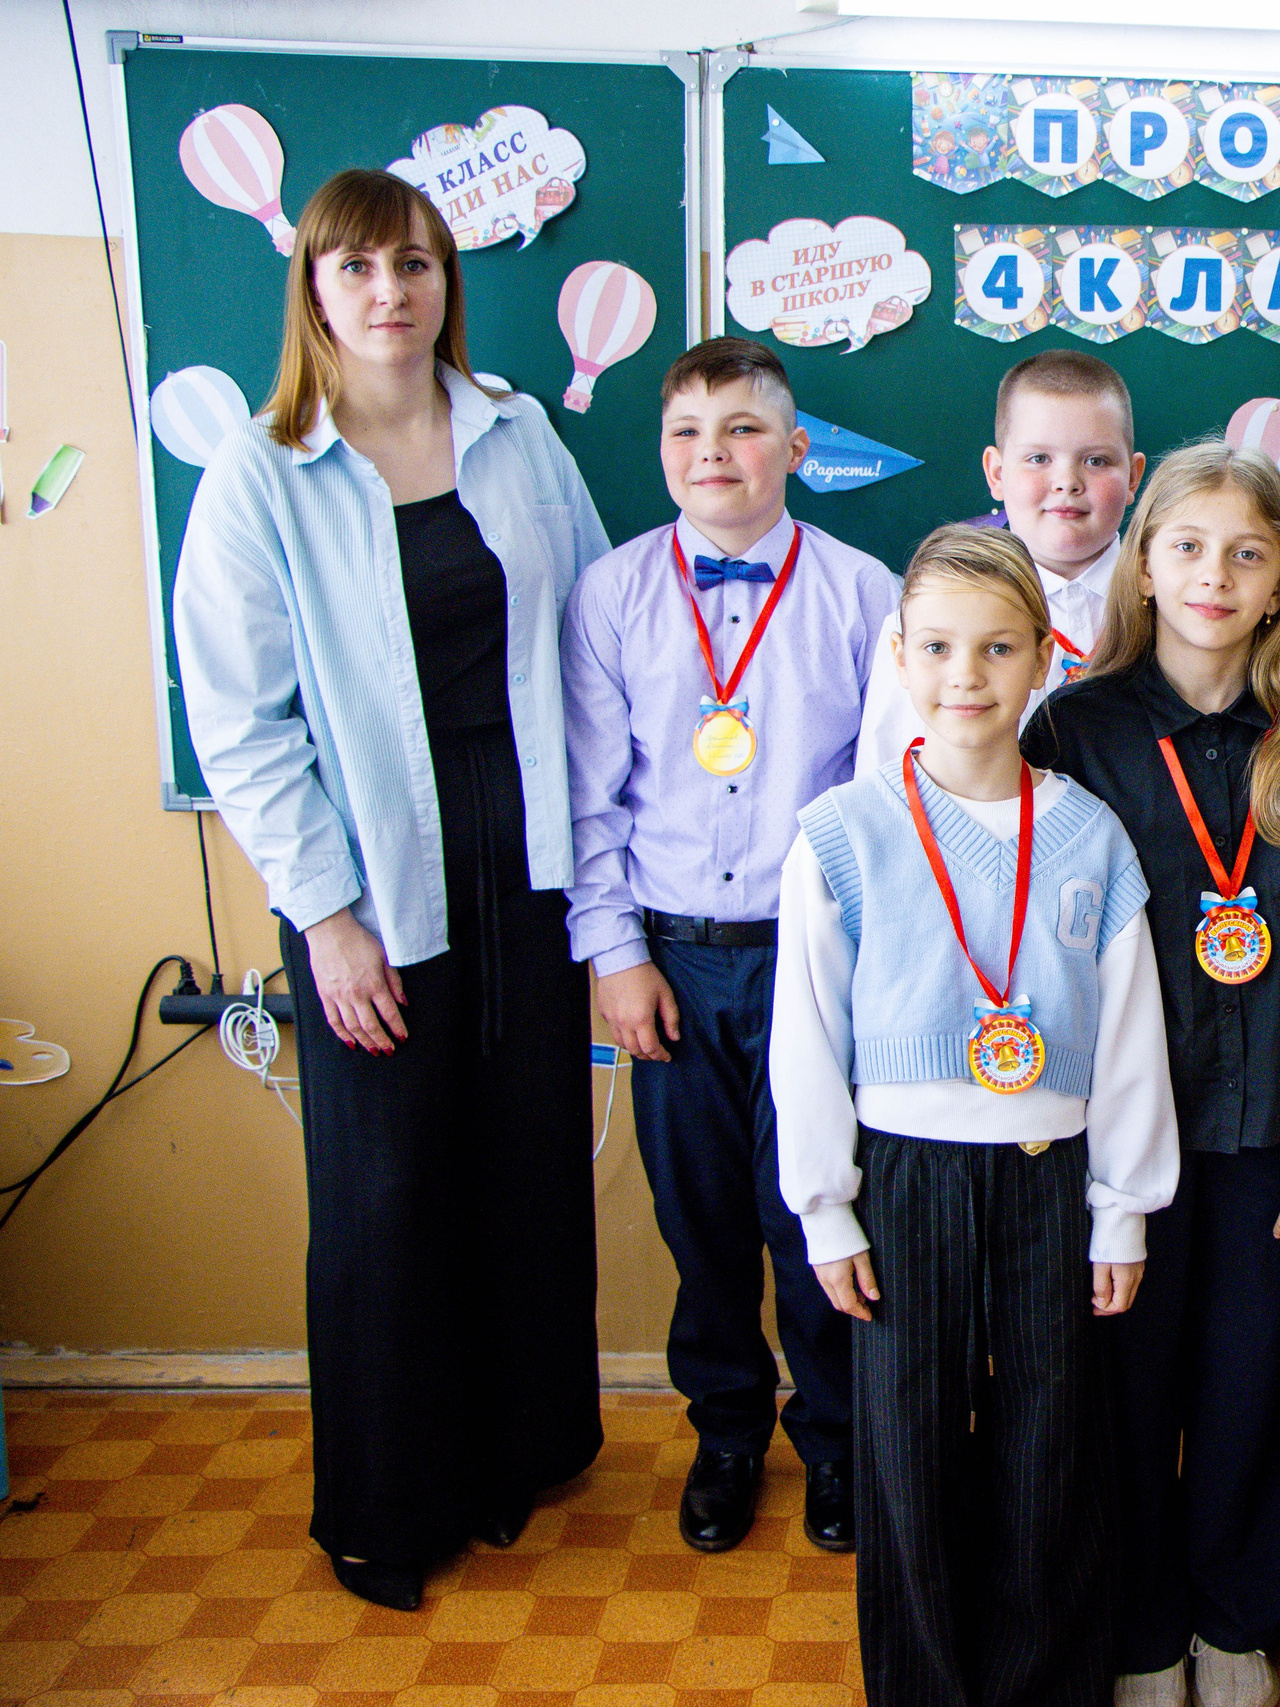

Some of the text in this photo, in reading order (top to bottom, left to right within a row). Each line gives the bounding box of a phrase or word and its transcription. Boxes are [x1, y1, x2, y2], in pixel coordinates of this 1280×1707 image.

[436, 131, 528, 195] КЛАСС
[438, 153, 549, 227] ДИ НАС
[751, 253, 893, 297] В СТАРШУЮ
[792, 241, 842, 267] ИДУ
[782, 279, 872, 313] ШКОЛУ
[981, 255, 1024, 310] 4
[803, 460, 882, 483] Радости!
